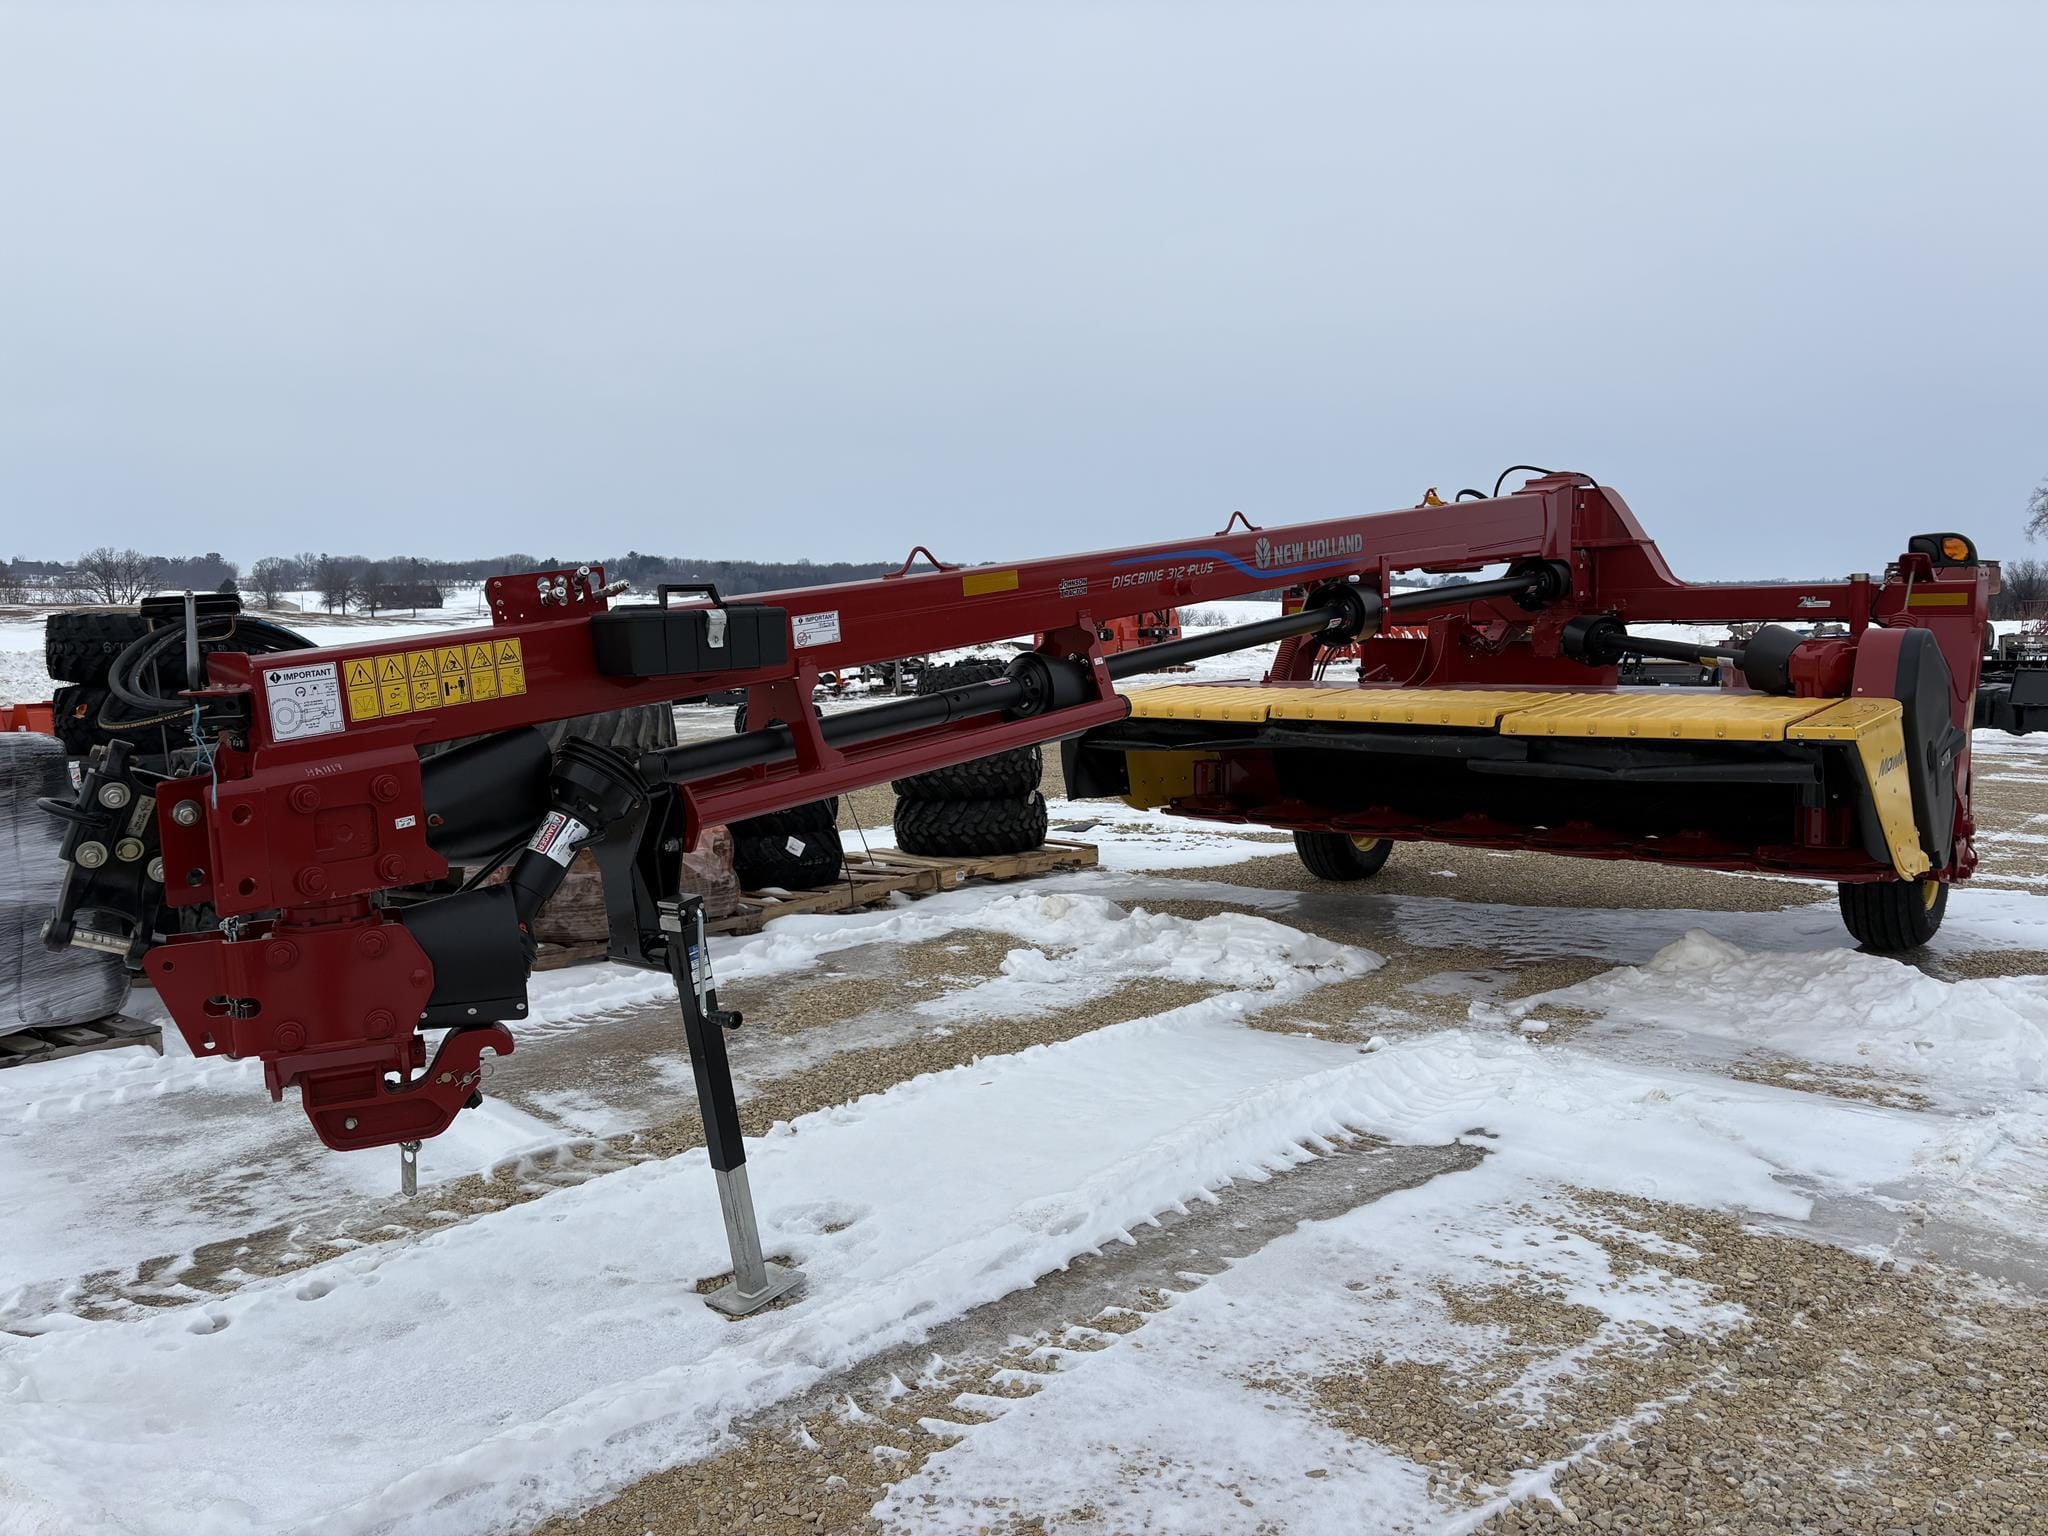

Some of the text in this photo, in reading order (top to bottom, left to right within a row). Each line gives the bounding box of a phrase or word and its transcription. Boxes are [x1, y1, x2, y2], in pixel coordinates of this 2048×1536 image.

[1273, 533, 1363, 566] NEW HOLLAND
[1060, 577, 1088, 589] JOHNSON
[1111, 569, 1164, 589] DISCBINE
[1167, 565, 1185, 580] 312
[1060, 586, 1088, 599] TRACTOR
[805, 613, 835, 623] IMPORTANT
[283, 668, 332, 681] IMPORTANT
[536, 823, 558, 851] DANGER
